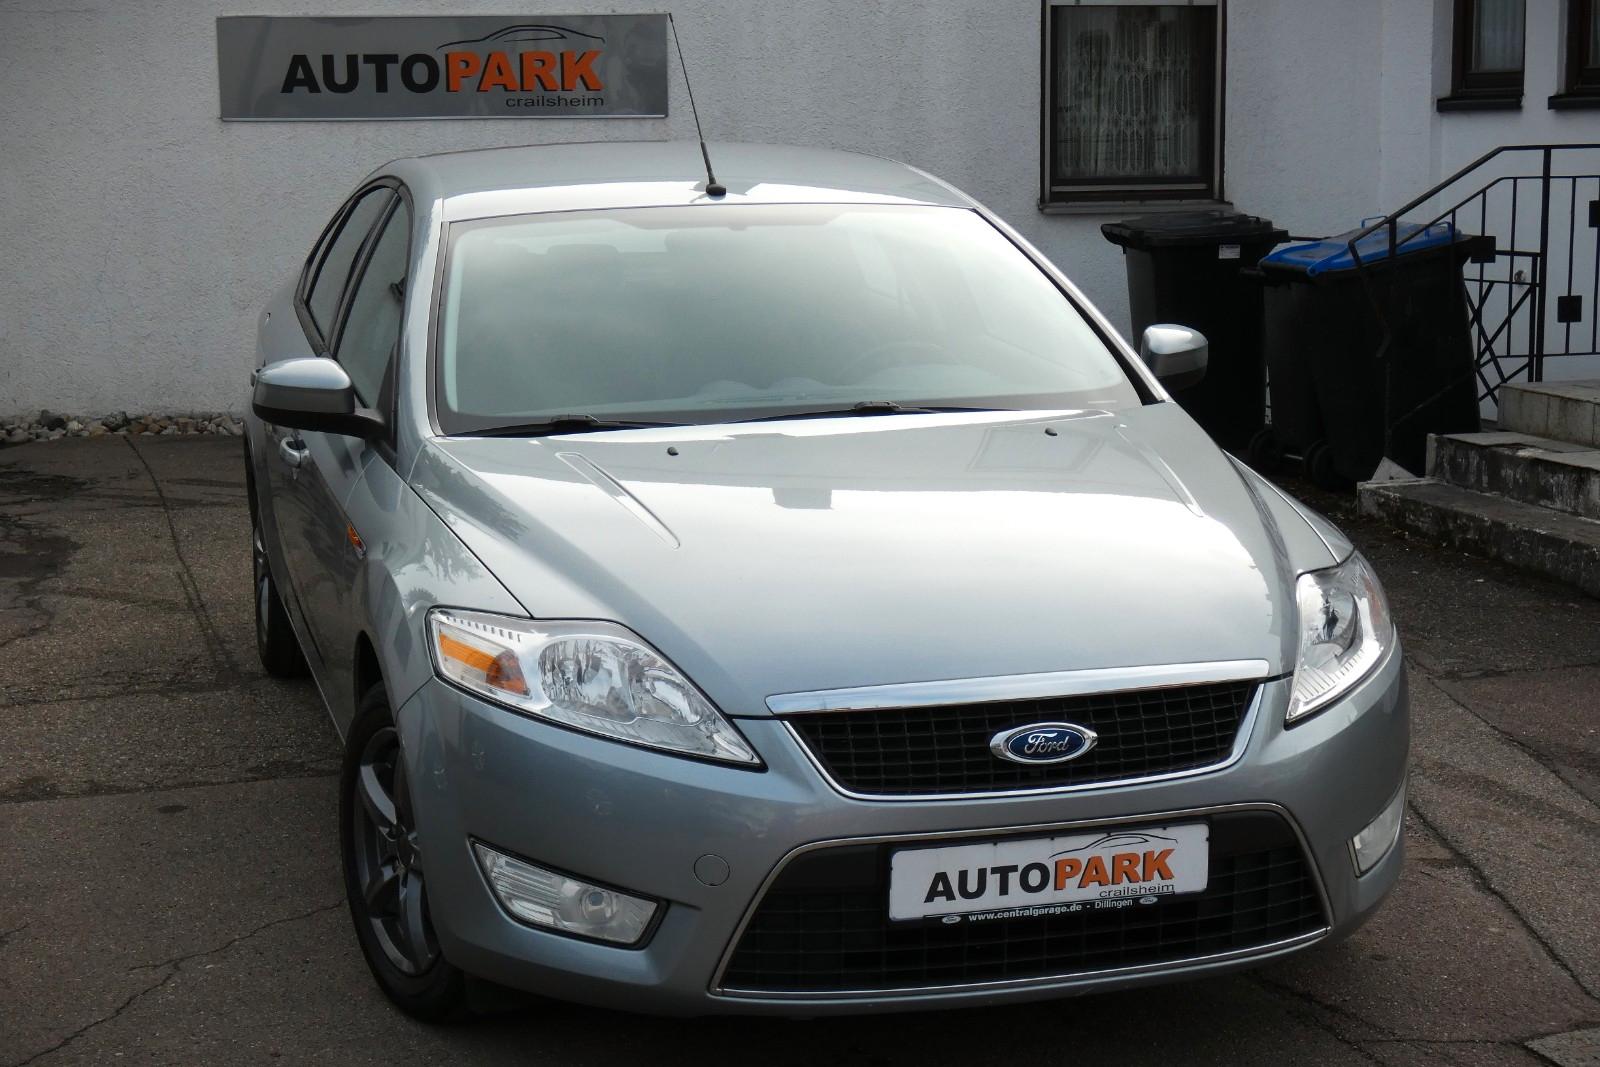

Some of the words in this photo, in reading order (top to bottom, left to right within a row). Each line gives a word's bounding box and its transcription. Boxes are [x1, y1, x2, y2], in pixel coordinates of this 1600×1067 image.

[280, 50, 605, 94] AUTOPARK
[505, 95, 605, 107] crailsheim
[1024, 732, 1070, 754] Ford
[923, 848, 1176, 903] AUTOPARK
[1099, 883, 1176, 898] crailsheim
[968, 904, 1083, 922] www.centralgarage.de
[1094, 898, 1133, 910] Dillingen
